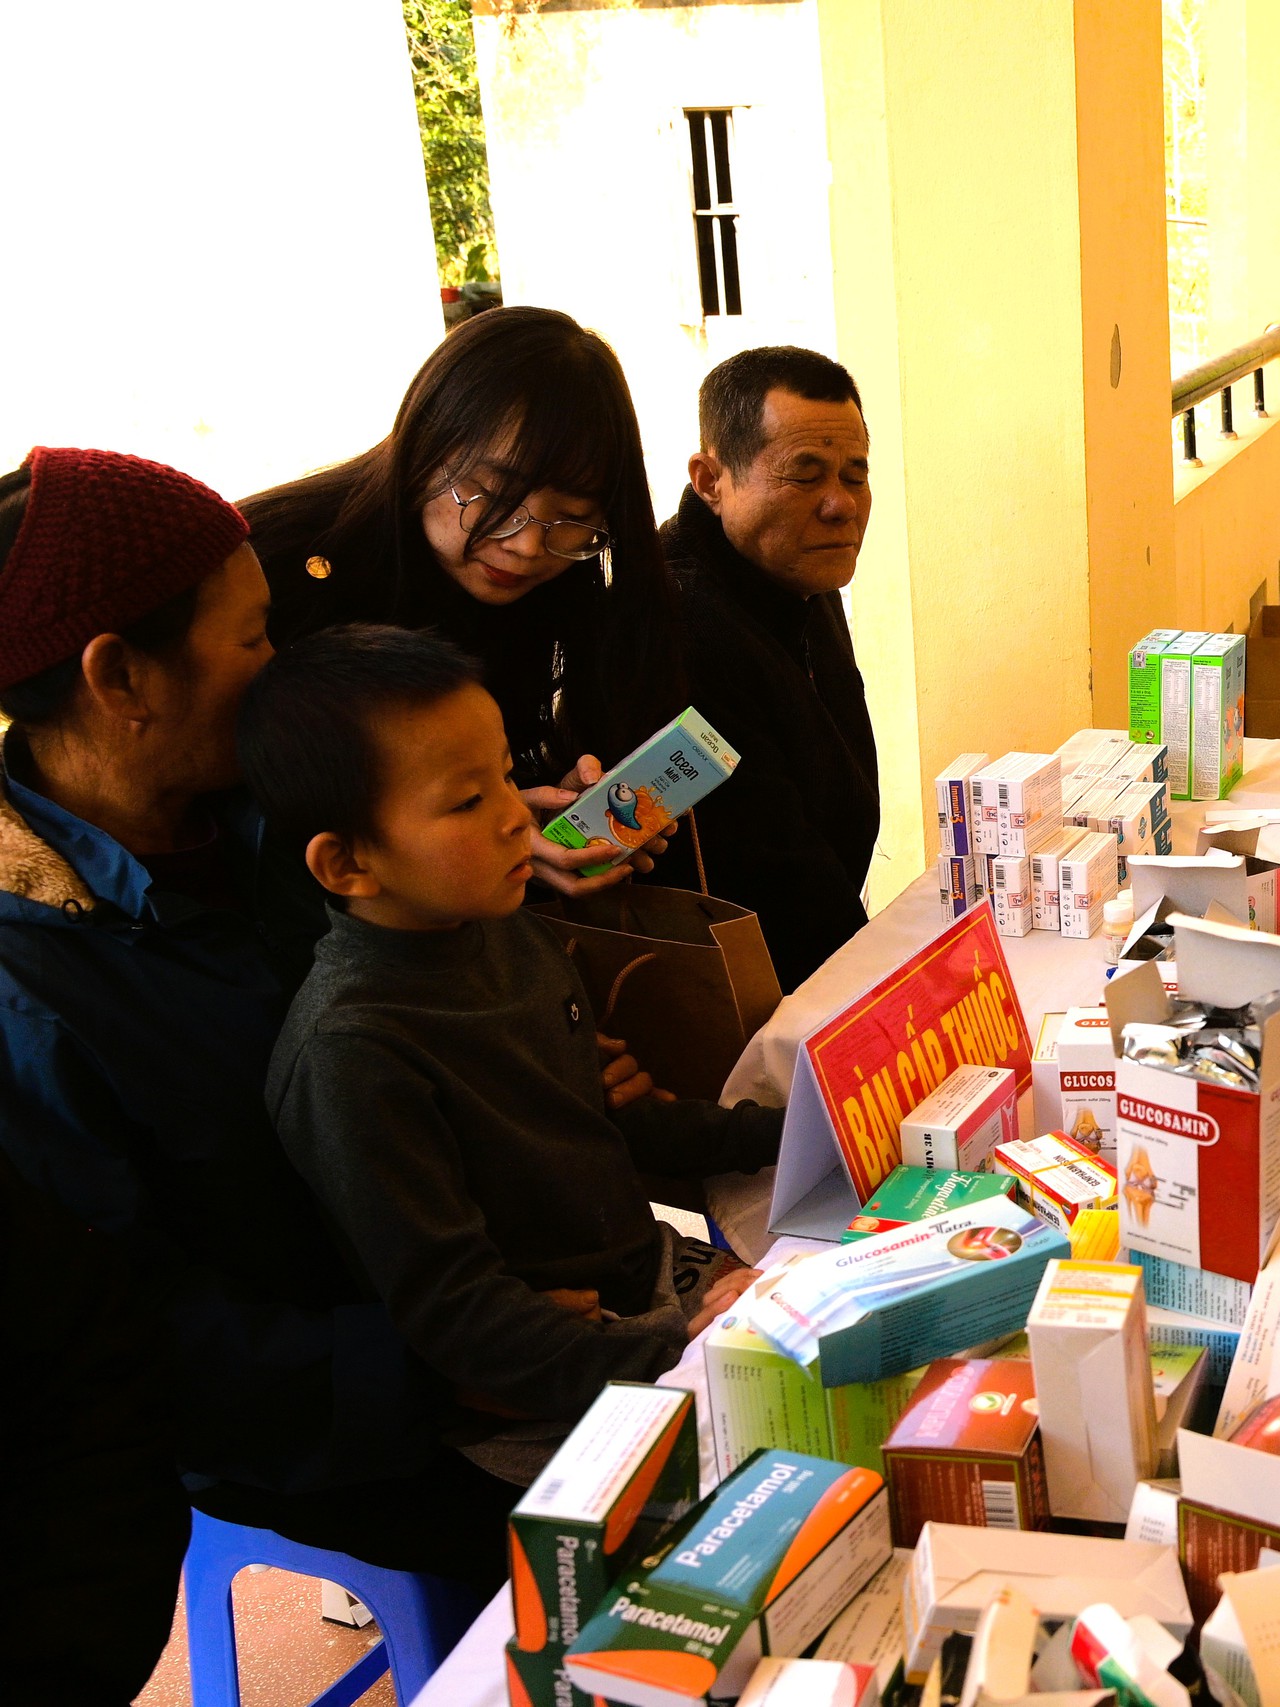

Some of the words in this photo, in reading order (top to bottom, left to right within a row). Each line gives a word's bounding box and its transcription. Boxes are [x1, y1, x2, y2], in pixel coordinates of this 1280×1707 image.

[663, 766, 684, 784] Multi
[669, 749, 700, 782] Ocean
[842, 1064, 904, 1189] BÀN
[896, 1004, 948, 1114] CẤP
[940, 950, 1019, 1068] THUỐC
[1063, 1075, 1116, 1088] GLUCOS
[1119, 1099, 1210, 1138] GLUCOSAMIN
[923, 1133, 933, 1147] 3B
[674, 1463, 799, 1568] Paracetamol
[607, 1595, 731, 1646] Paracetamol
